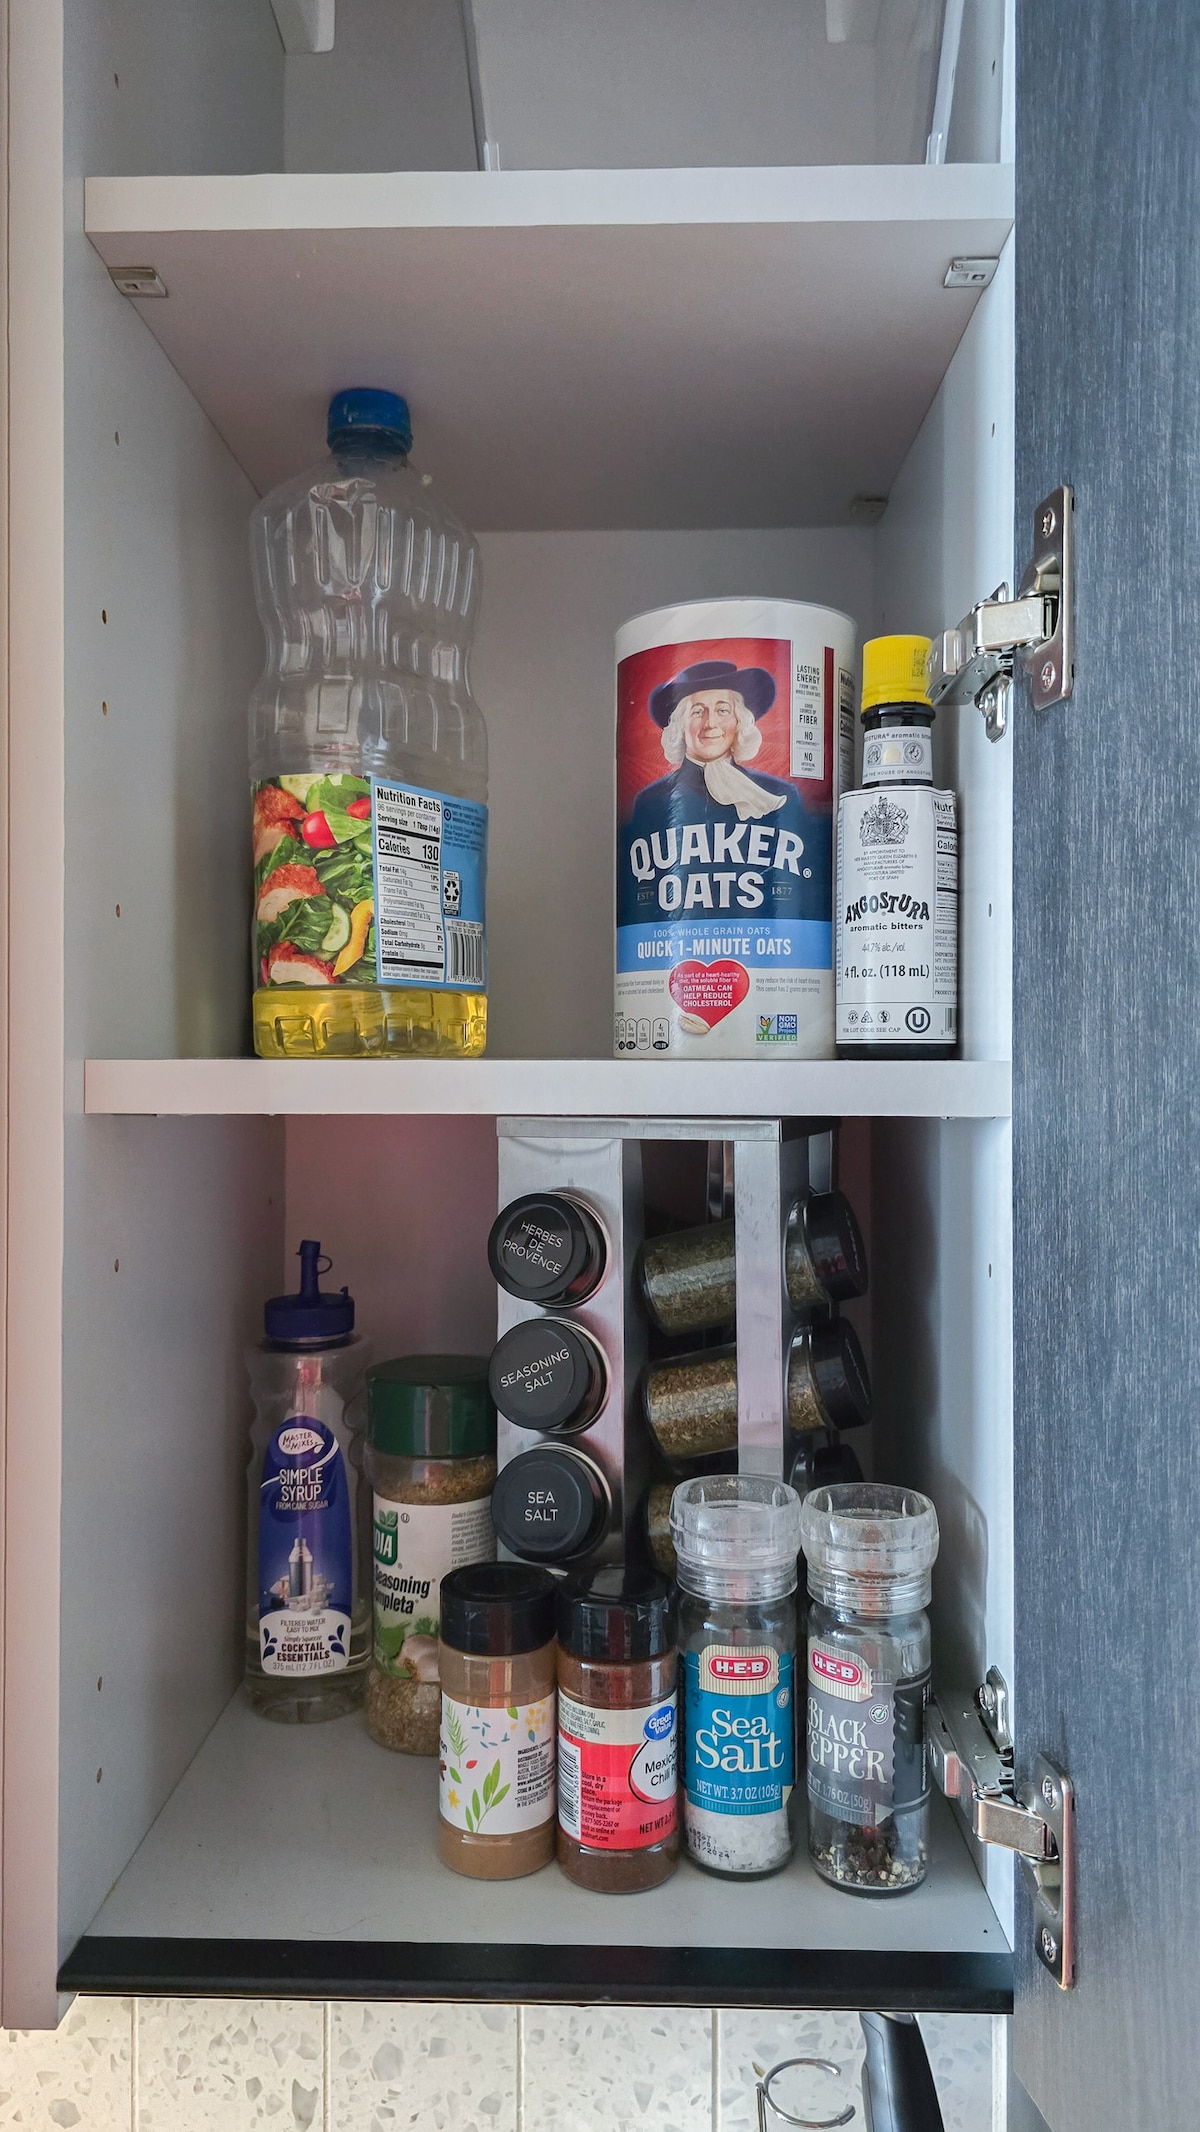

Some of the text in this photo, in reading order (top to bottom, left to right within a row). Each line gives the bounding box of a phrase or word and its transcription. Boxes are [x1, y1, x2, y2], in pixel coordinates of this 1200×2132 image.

[797, 664, 820, 675] LASTING
[797, 673, 820, 684] ENERGY
[800, 715, 818, 725] FIBER
[804, 732, 813, 740] NO
[804, 752, 812, 762] NO
[377, 787, 416, 806] Nutrition
[418, 797, 441, 813] Facts
[378, 814, 398, 826] Serving
[417, 821, 428, 832] Tbsp
[378, 838, 439, 861] Calories 130
[629, 822, 805, 884] QUAKER
[658, 872, 765, 912] OATS
[771, 886, 793, 896] 1877
[845, 892, 930, 924] ANGOSTURA
[380, 918, 406, 926] Cholesterol
[850, 922, 923, 932] aromatic bitters
[653, 926, 771, 938] 100% WHOLE GRAIN OATS
[637, 938, 792, 960] QUICK 1-MINUTE OATS
[862, 968, 877, 978] oz.
[880, 964, 906, 979] (118
[909, 964, 930, 979] mL)
[520, 1221, 564, 1248] HERBES
[528, 1238, 546, 1253] DE
[503, 1239, 562, 1275] PROVENCE
[500, 1348, 570, 1389] SEASONING
[524, 1371, 554, 1393] SALT
[282, 1432, 313, 1446] MASTER
[291, 1439, 314, 1450] MIXES
[280, 1467, 323, 1485] SIMPLE
[281, 1484, 322, 1502] SYRUP
[527, 1491, 556, 1504] SEA
[276, 1500, 329, 1510] FROM CANE SUGAR
[524, 1509, 558, 1522] SALT
[307, 1618, 326, 1626] WATER
[281, 1642, 325, 1652] COCKTAIL
[277, 1650, 330, 1662] ESSENTIALS
[273, 1662, 284, 1670] 375
[715, 1660, 764, 1674] H-E-B
[814, 1655, 854, 1679] H-E-B
[648, 1710, 672, 1729] Great
[711, 1708, 770, 1738] Sea
[808, 1696, 868, 1750] BLACK
[655, 1720, 672, 1735] Value
[695, 1729, 785, 1773] Salt
[581, 1770, 595, 1781] Store
[596, 1774, 601, 1782] in
[650, 1770, 670, 1787] Chili
[581, 1779, 604, 1791] cool, dry
[581, 1786, 597, 1796] place.
[696, 1779, 781, 1800] NET WT. 3.7 OZ (105g)
[604, 1798, 622, 1806] package
[837, 1789, 850, 1804] OZ
[850, 1794, 872, 1812] (50g)
[581, 1809, 595, 1819] money
[588, 1803, 615, 1813] replacement
[596, 1827, 610, 1835] online
[640, 1821, 653, 1834] NET
[654, 1817, 664, 1831] WT
